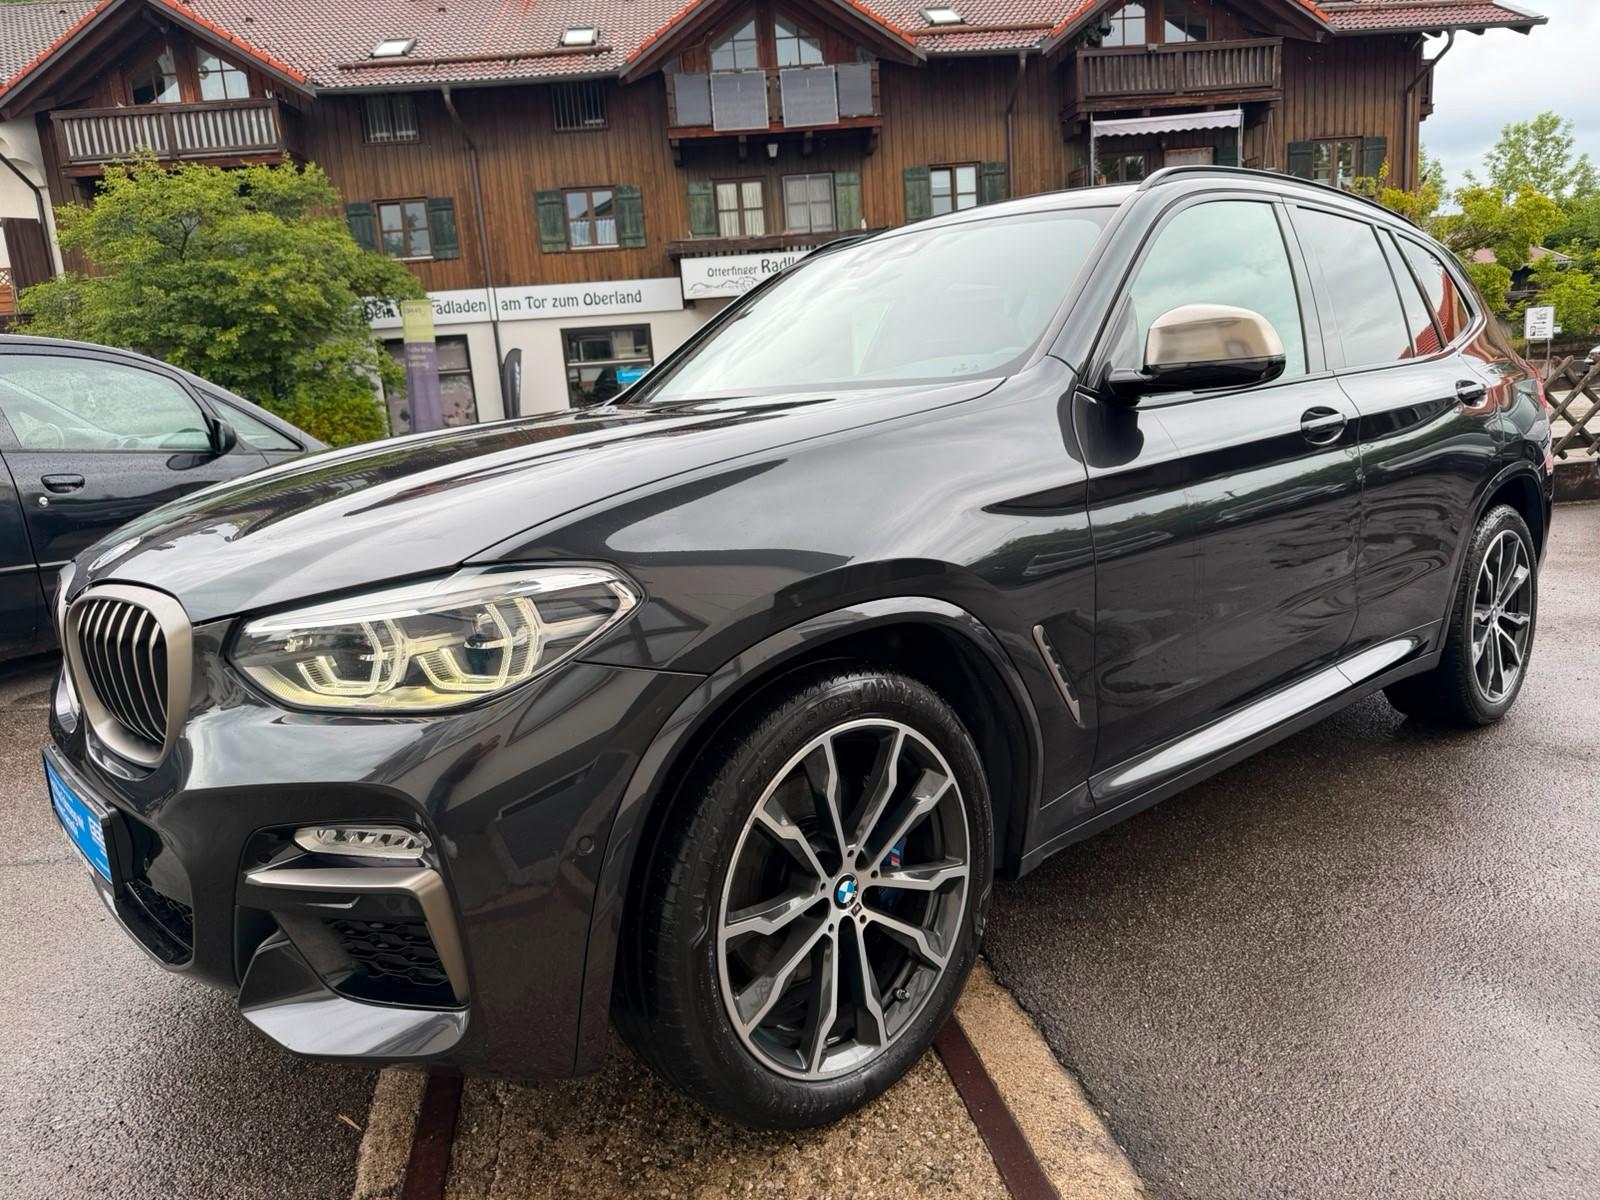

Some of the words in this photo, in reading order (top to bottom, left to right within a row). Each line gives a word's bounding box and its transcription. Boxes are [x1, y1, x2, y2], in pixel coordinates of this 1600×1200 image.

[707, 265, 758, 277] Otterfinger
[501, 299, 521, 311] am
[524, 296, 547, 310] Tor
[552, 295, 579, 308] zum
[583, 289, 642, 306] Oberland
